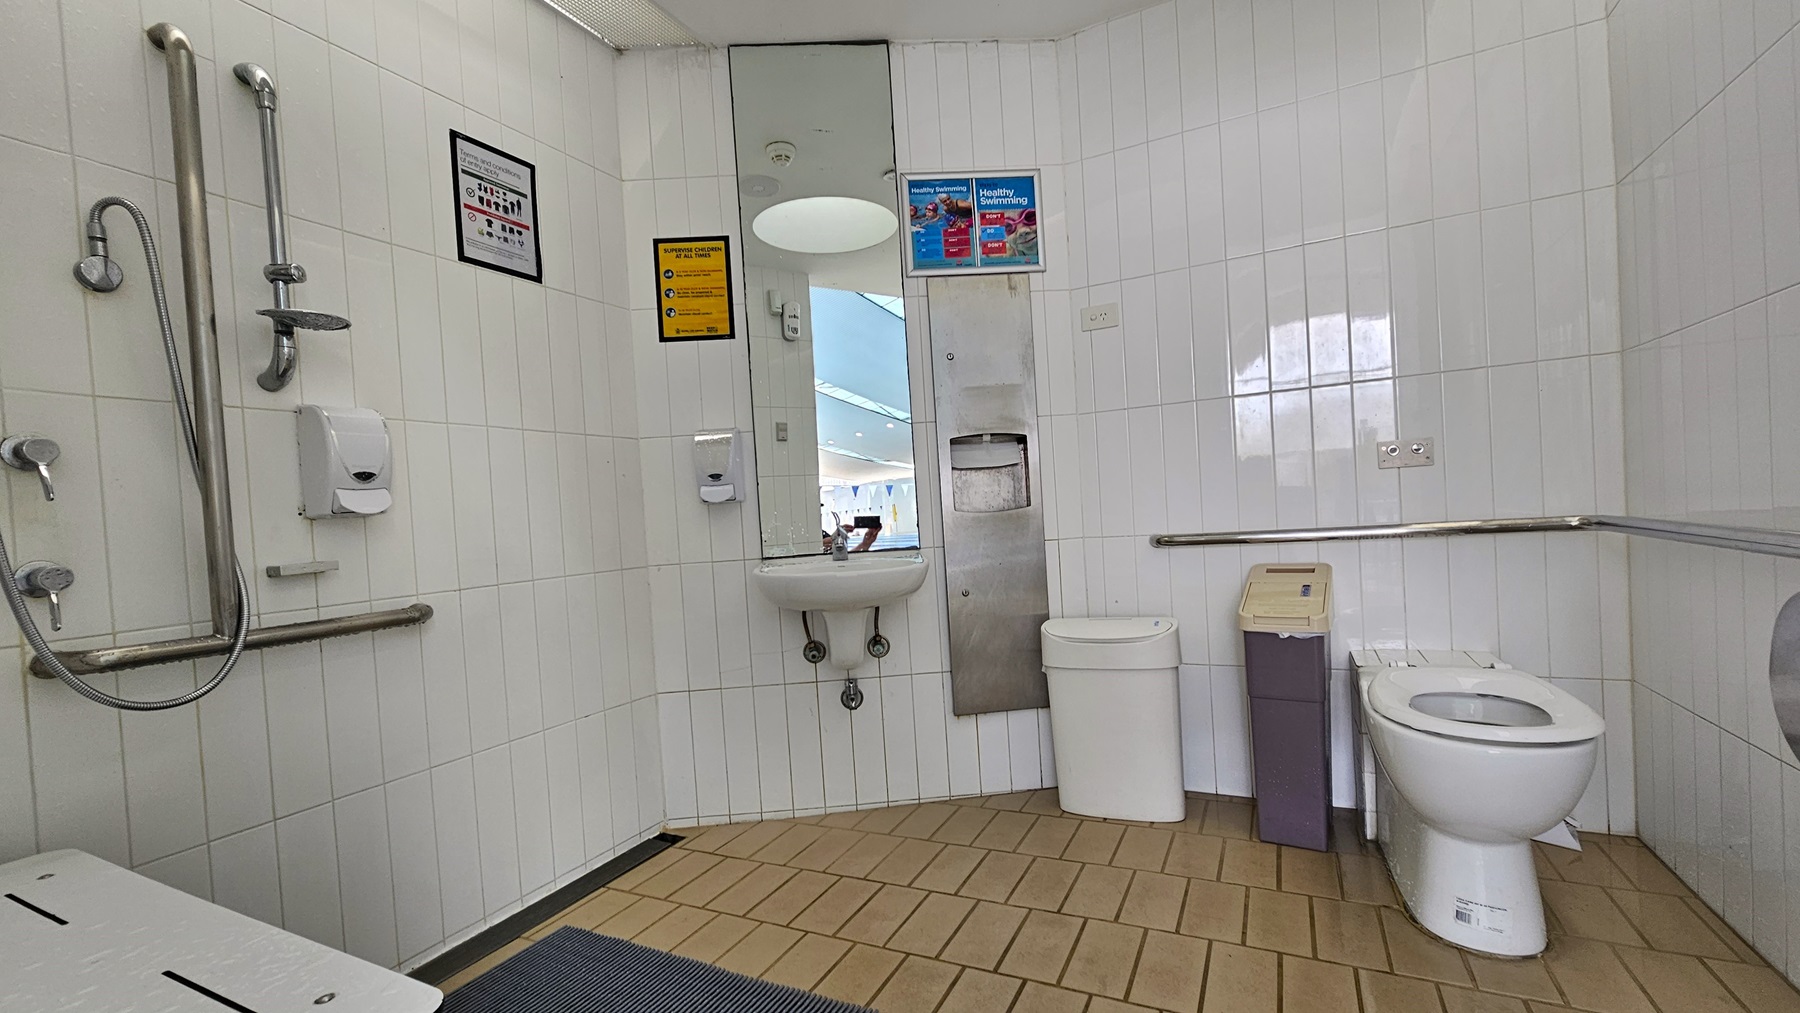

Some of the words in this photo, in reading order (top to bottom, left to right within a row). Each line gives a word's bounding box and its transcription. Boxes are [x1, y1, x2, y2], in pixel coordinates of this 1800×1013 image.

[459, 148, 479, 161] Terms
[480, 158, 492, 167] and
[492, 163, 521, 180] conditions
[460, 156, 467, 164] of
[467, 160, 482, 171] entry
[483, 167, 499, 178] apply
[979, 188, 1014, 197] Healthy
[980, 196, 1028, 206] Swimming
